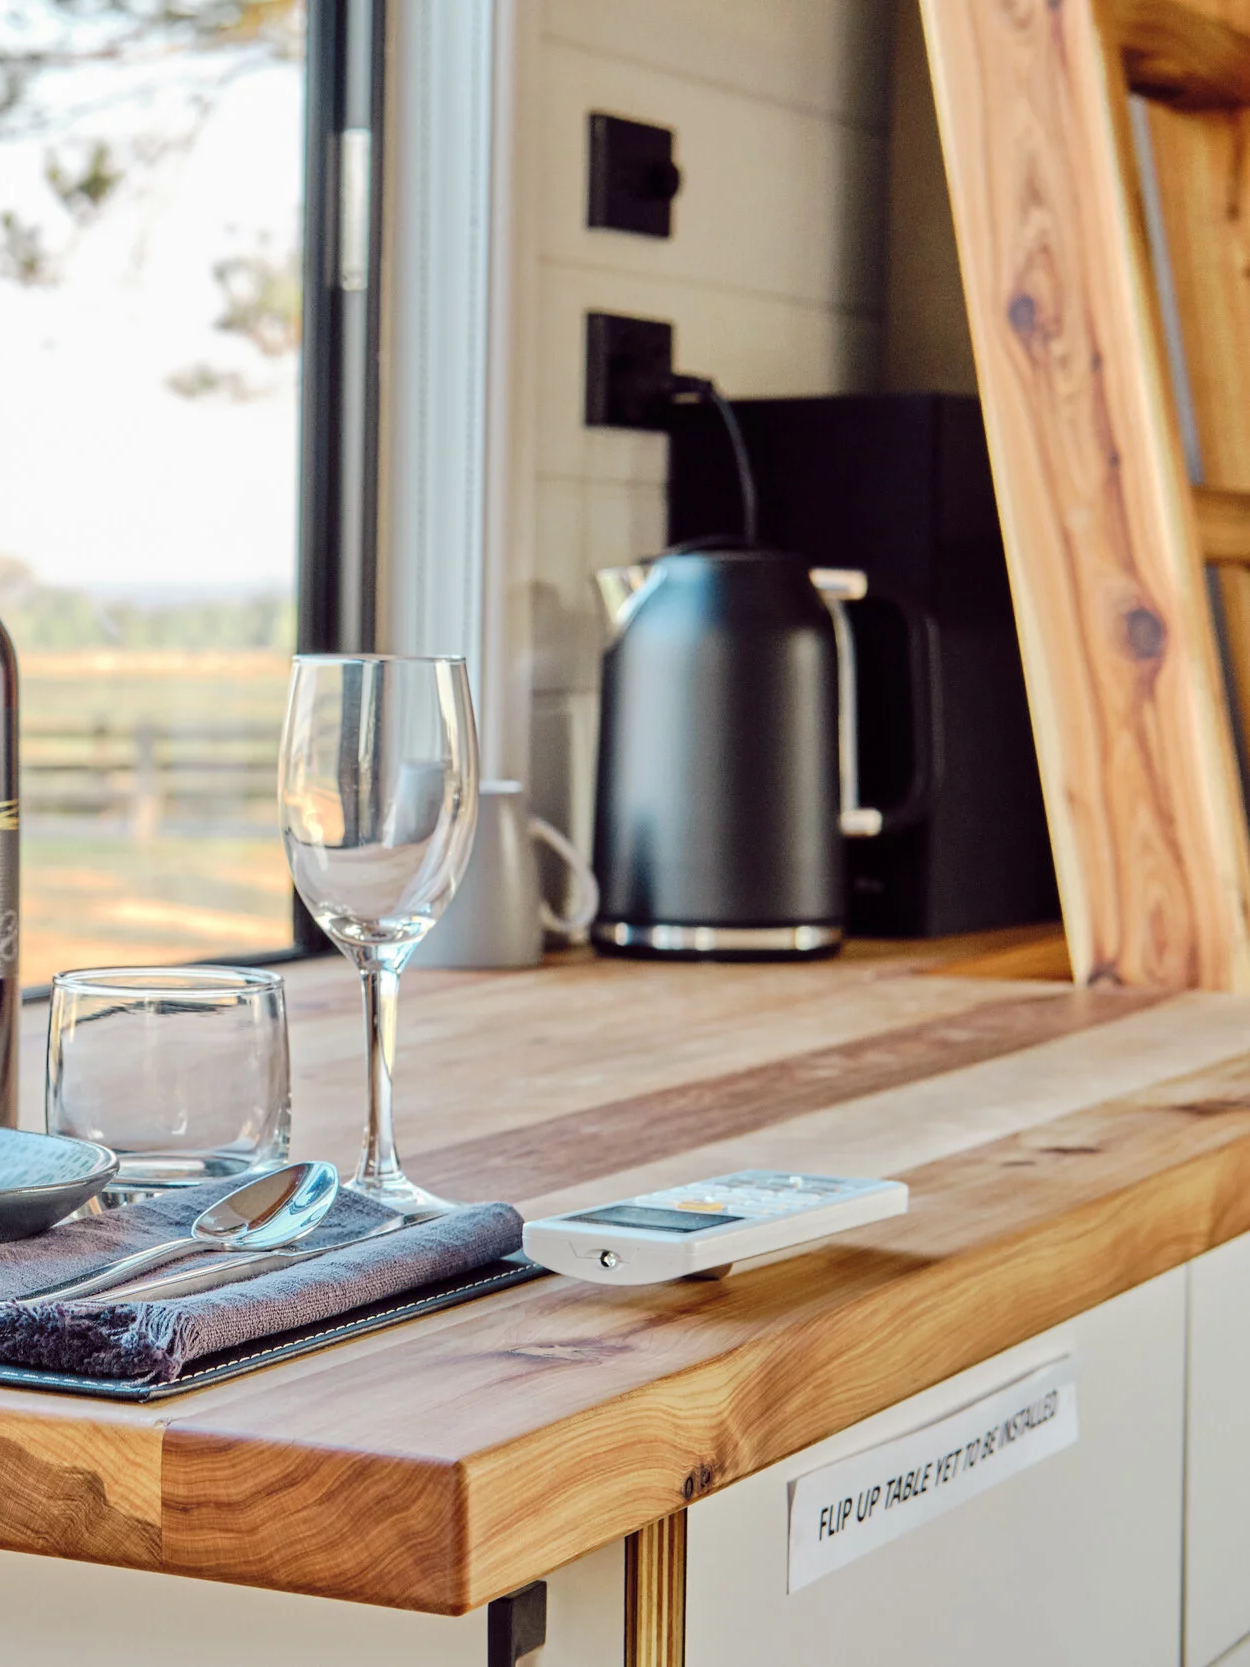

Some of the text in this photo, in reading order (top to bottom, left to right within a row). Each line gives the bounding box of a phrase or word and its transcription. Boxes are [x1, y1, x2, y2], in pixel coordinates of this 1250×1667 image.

[819, 1390, 1057, 1541] FLIP UP TABLE YET TO BE INSTALLED
